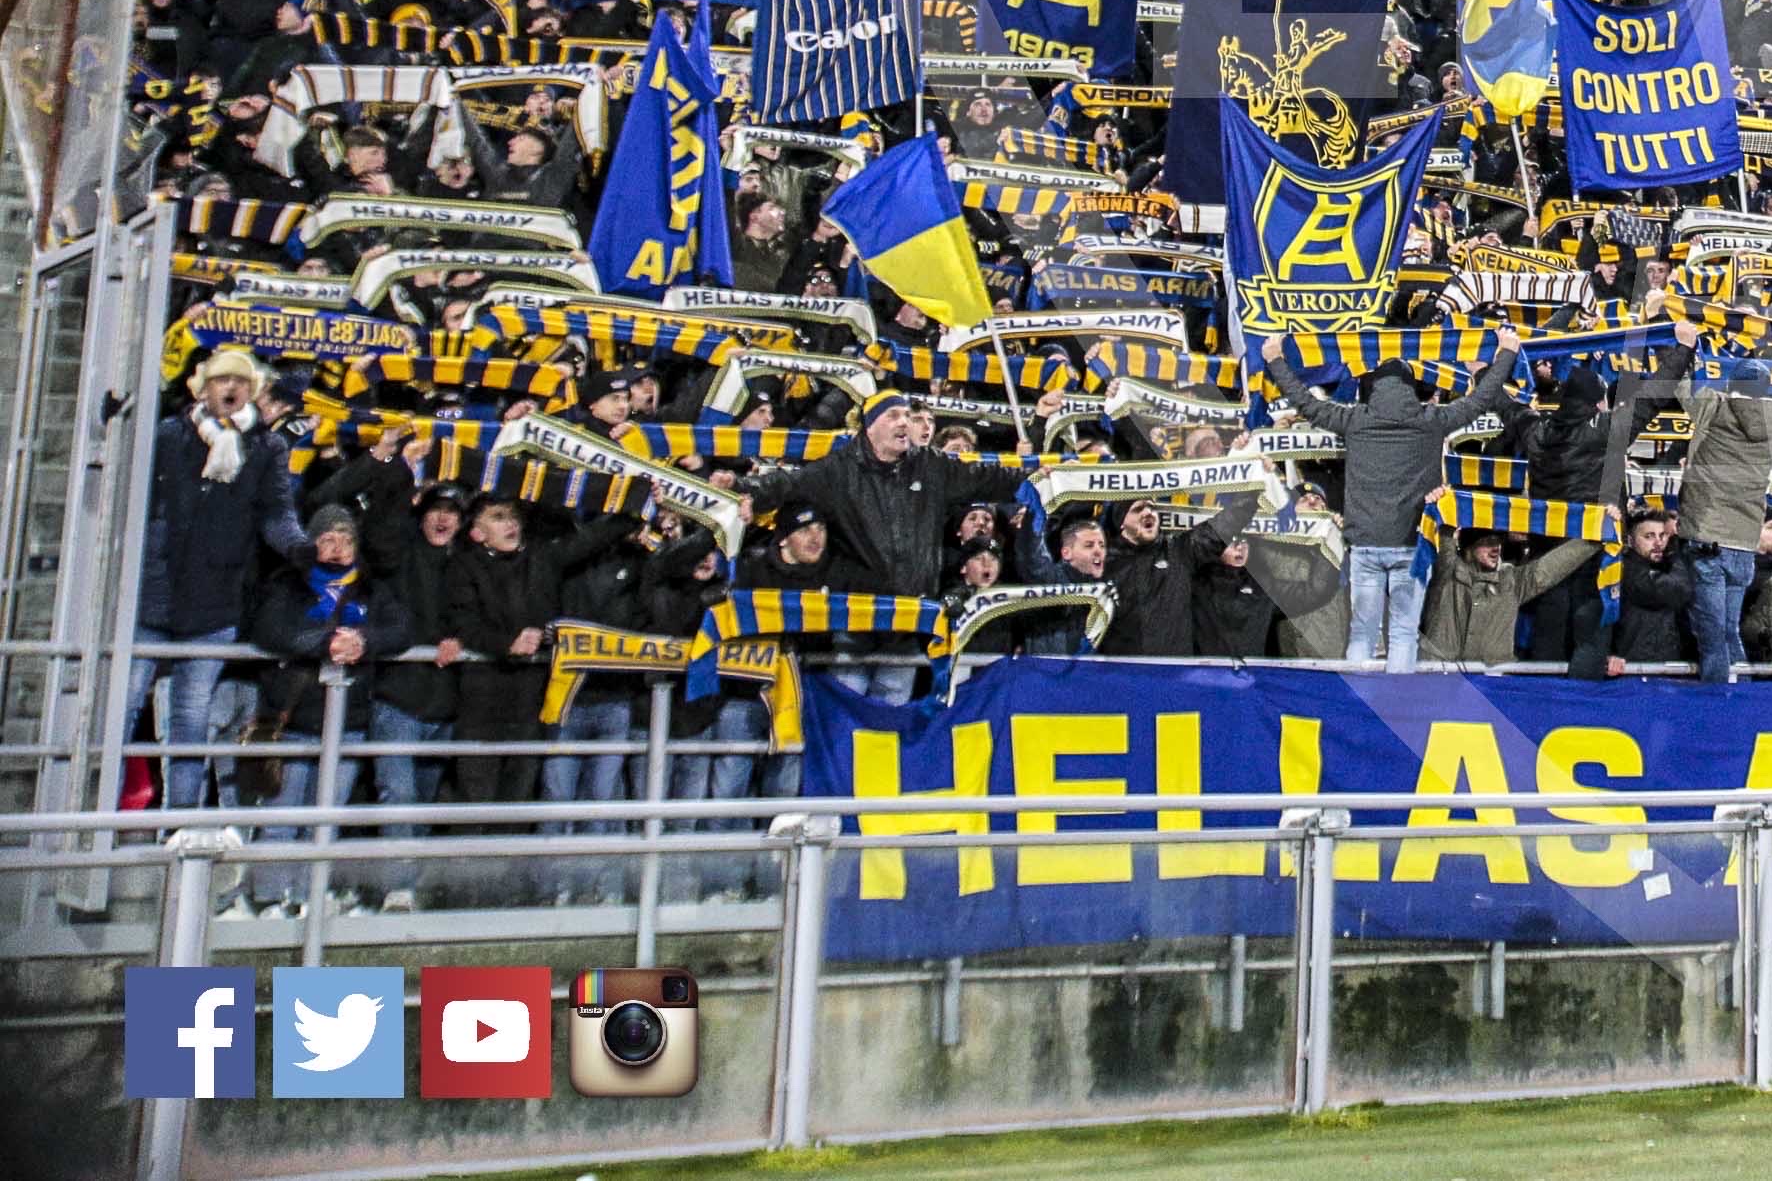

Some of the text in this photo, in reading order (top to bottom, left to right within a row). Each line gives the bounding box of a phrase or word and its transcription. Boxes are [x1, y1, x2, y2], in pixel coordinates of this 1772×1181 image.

[1140, 4, 1182, 17] HELL
[1593, 10, 1679, 54] SOLI
[1003, 28, 1094, 70] 1903
[1080, 87, 1172, 105] VERON
[1572, 62, 1721, 115] CONTRO
[1596, 127, 1716, 175] TUTTI
[966, 167, 1041, 185] HELLAS
[351, 205, 535, 227] HELLAS ARMY
[1076, 197, 1134, 215] ERONA
[1078, 234, 1180, 251] ELLAS
[1701, 237, 1763, 251] HELLAS
[236, 278, 309, 298] ELLAS
[1035, 272, 1211, 299] HELLAS ARM
[684, 290, 845, 315] HELLAS ARMY
[1273, 290, 1372, 312] VERONA
[969, 314, 1181, 335] HELLAS ARMY
[921, 394, 1040, 419] ELLAS ARM
[1060, 400, 1101, 415] HELL
[1142, 392, 1224, 418] HELLAS
[1464, 415, 1505, 432] HELL
[1259, 435, 1346, 452] HELLAS
[524, 417, 720, 511] HELLAS ARMY
[1089, 464, 1252, 491] HELLAS ARMY
[556, 630, 684, 661] HELLAS
[853, 711, 1648, 902] HELLAS
